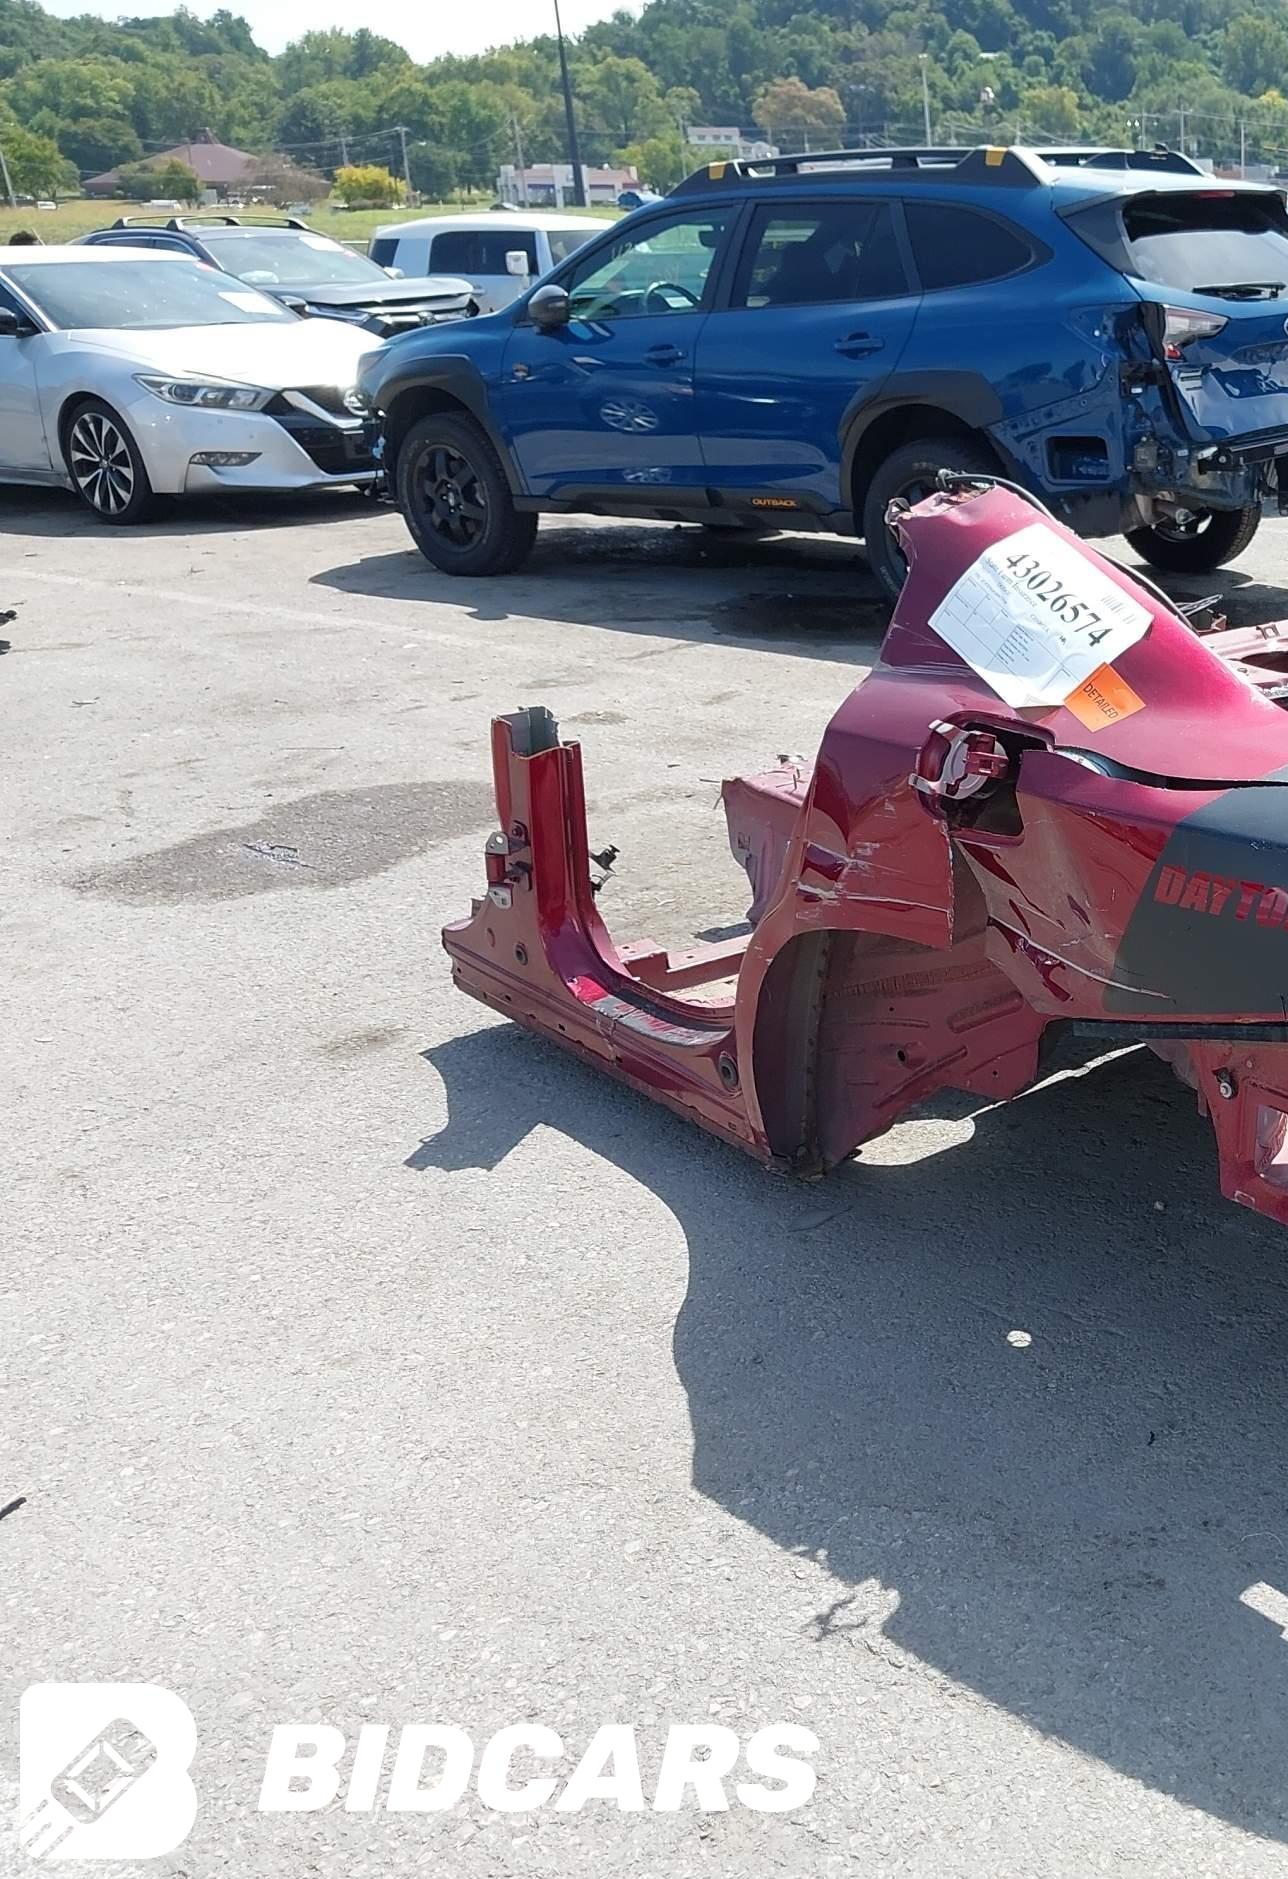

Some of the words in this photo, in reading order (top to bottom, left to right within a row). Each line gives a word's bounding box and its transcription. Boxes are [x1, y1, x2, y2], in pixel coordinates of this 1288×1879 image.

[752, 498, 798, 507] OUTBACK
[1006, 554, 1113, 647] 43026574
[1083, 682, 1119, 719] DETAILED
